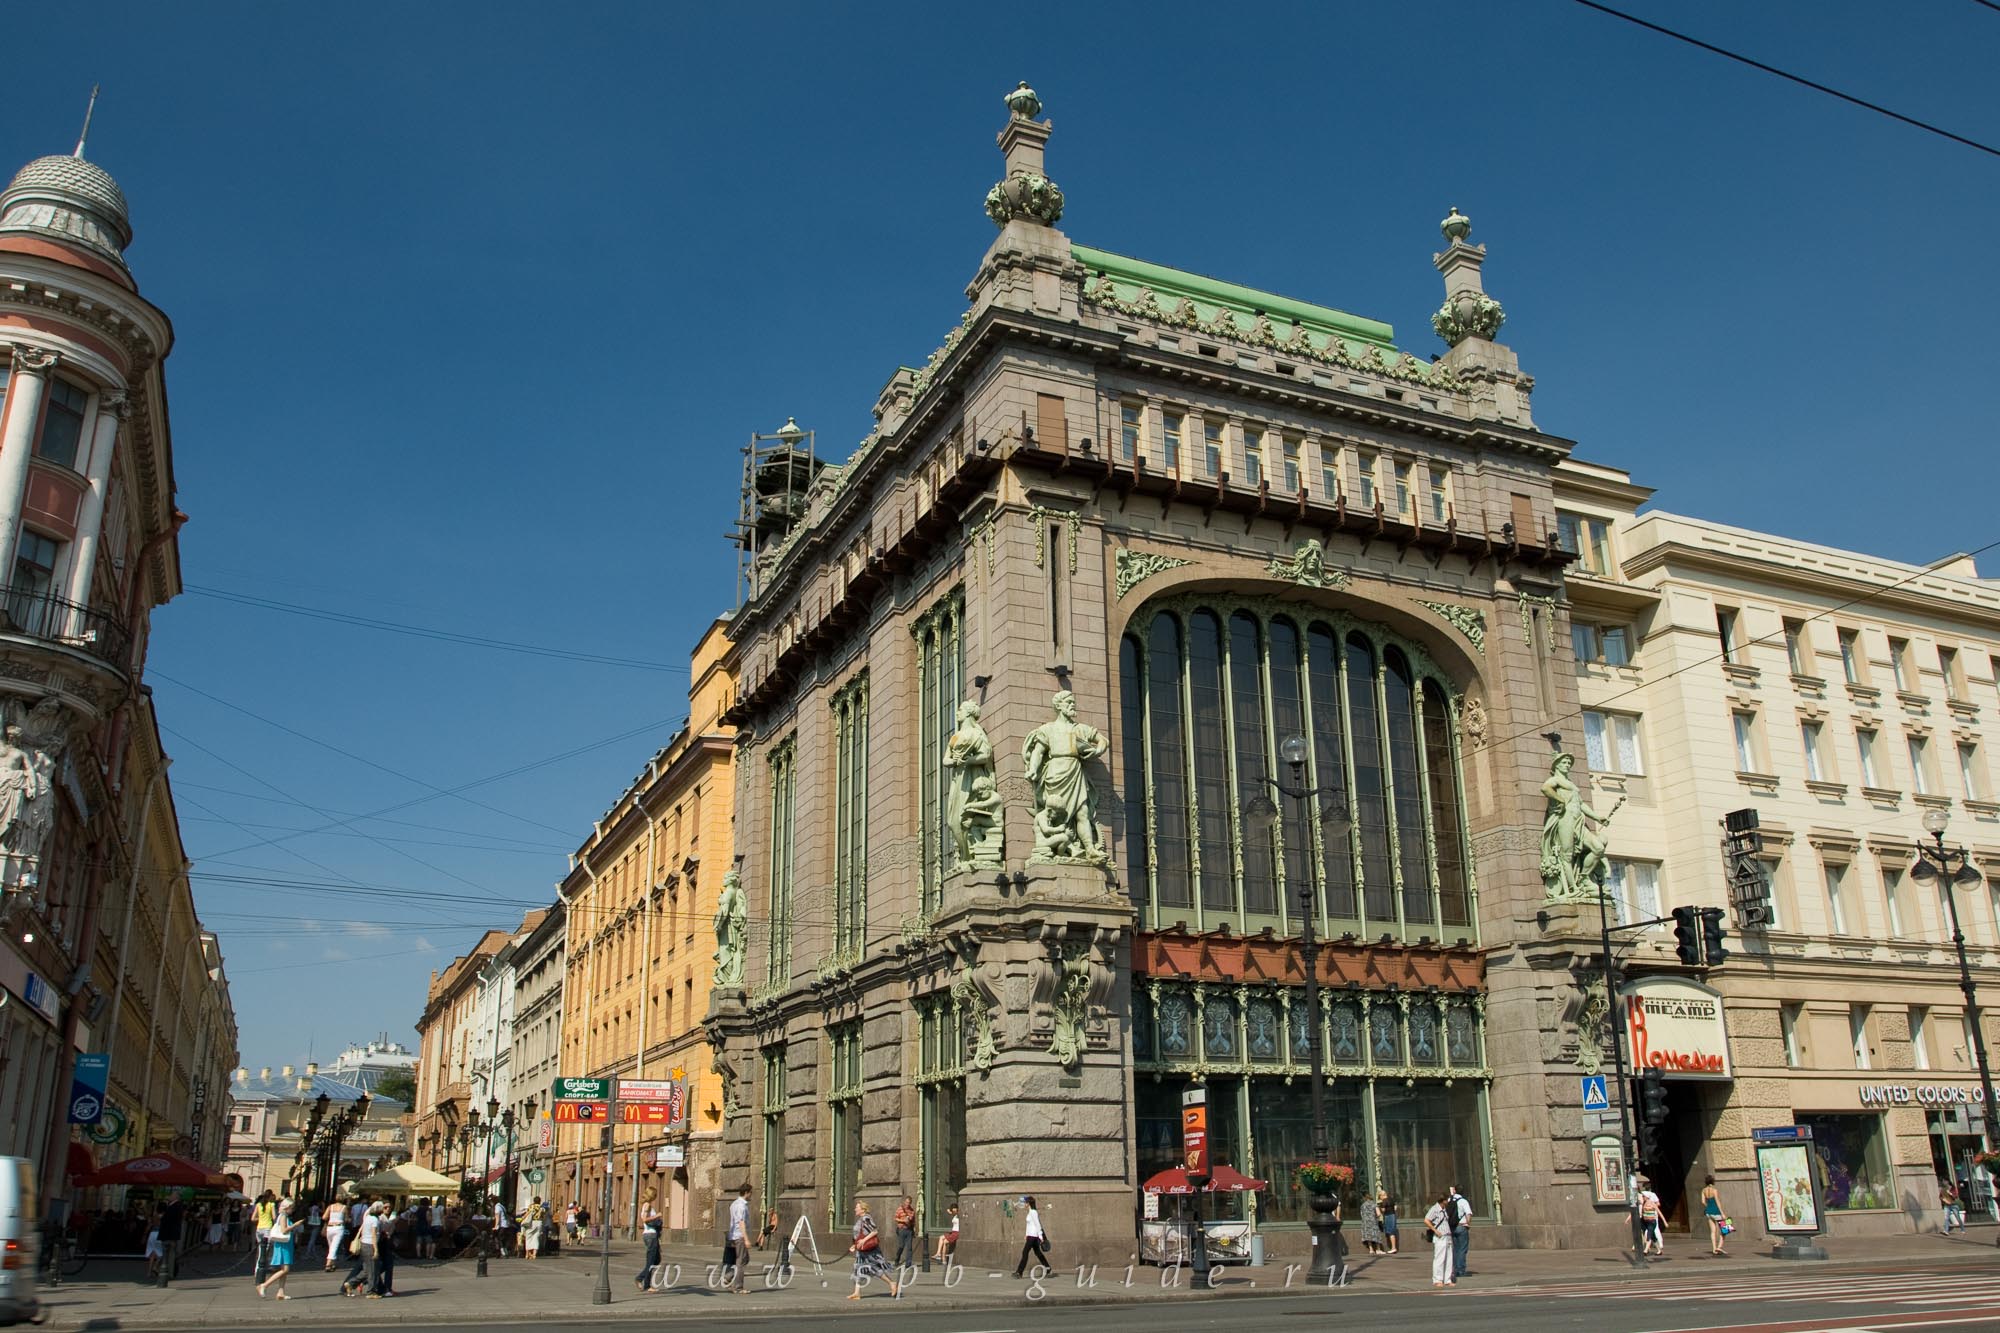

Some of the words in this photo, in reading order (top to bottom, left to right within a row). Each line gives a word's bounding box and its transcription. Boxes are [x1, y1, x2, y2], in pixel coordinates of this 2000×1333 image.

[564, 1079, 599, 1092] Carlsberg
[1859, 1086, 1909, 1102] UNITED
[1916, 1087, 1967, 1104] COLORS
[1973, 1087, 1987, 1103] O
